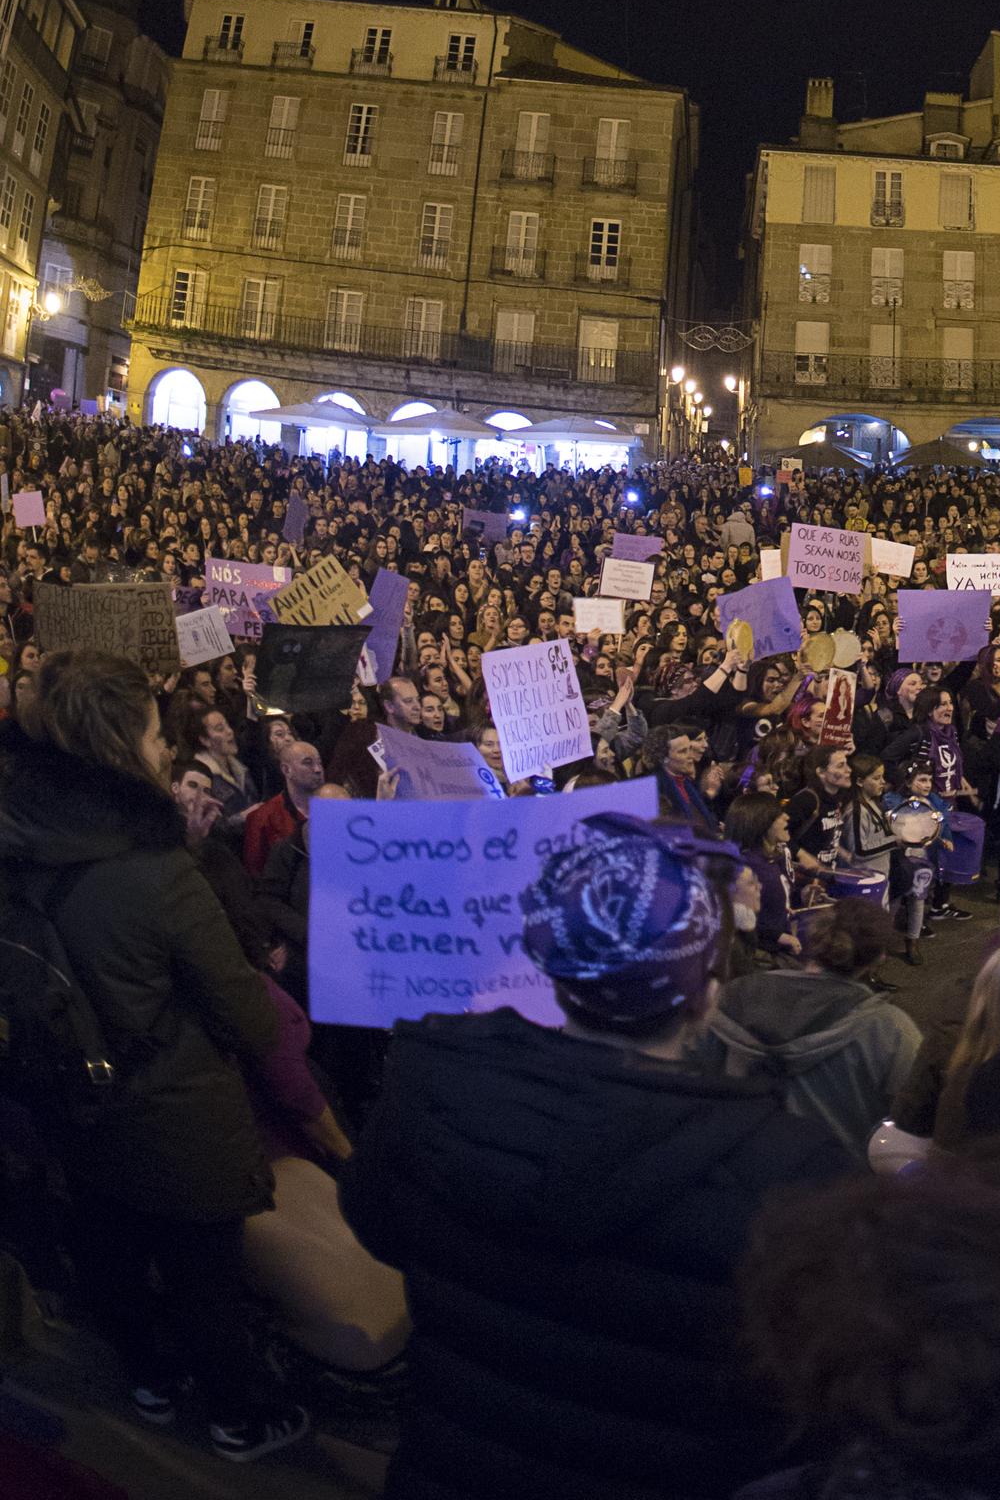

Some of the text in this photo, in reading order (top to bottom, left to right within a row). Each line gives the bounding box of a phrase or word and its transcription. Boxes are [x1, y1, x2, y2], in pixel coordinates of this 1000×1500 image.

[798, 528, 860, 547] QUE AS RUAS
[805, 544, 834, 559] SEXAN
[211, 563, 242, 585] NÓS
[794, 560, 827, 579] TODOS
[954, 577, 976, 590] YA
[212, 587, 250, 608] PARA
[547, 645, 567, 663] GRL
[527, 658, 547, 682] LAS
[546, 680, 565, 709] LAS
[565, 707, 582, 732] NO
[346, 816, 473, 865] Somos
[482, 828, 519, 861] el
[463, 890, 512, 930] que
[353, 925, 481, 956] tienen
